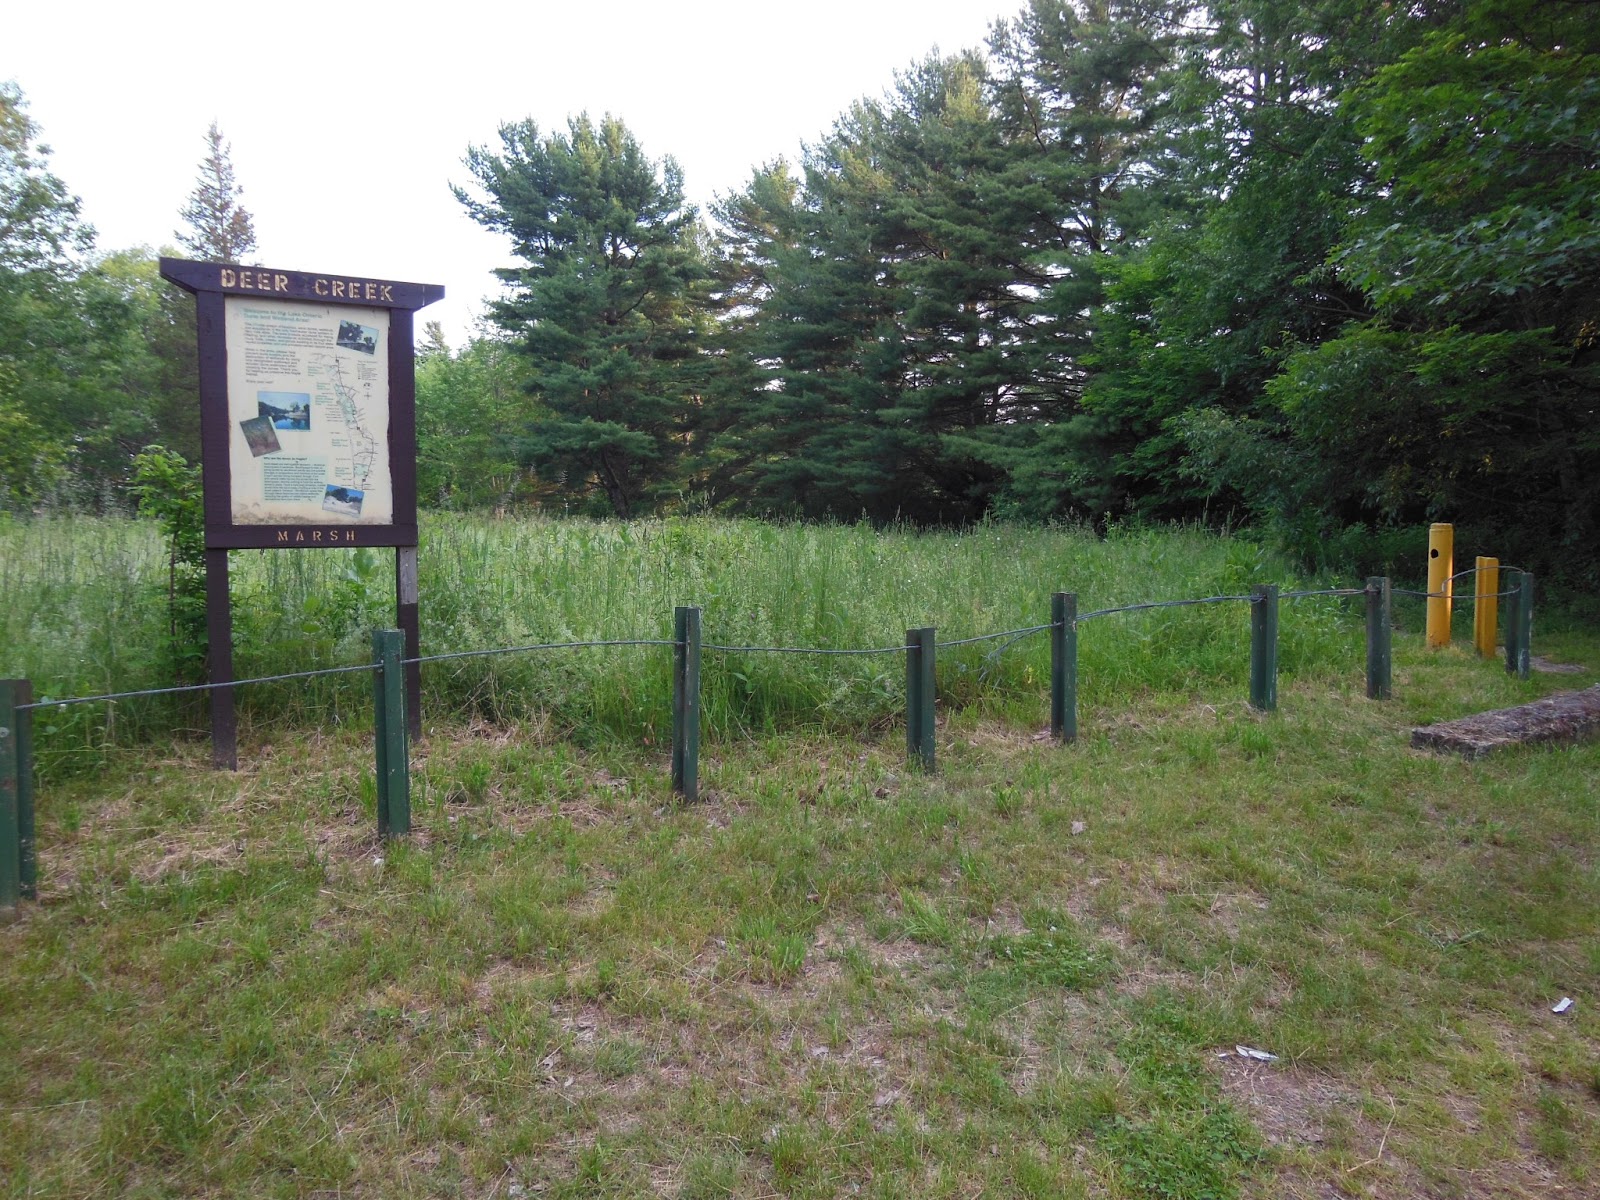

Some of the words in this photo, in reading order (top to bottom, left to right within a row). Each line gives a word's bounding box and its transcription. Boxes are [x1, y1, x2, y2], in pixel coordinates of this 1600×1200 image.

[221, 268, 289, 292] DEER
[315, 279, 393, 302] CREEK
[278, 530, 355, 541] MARSH
